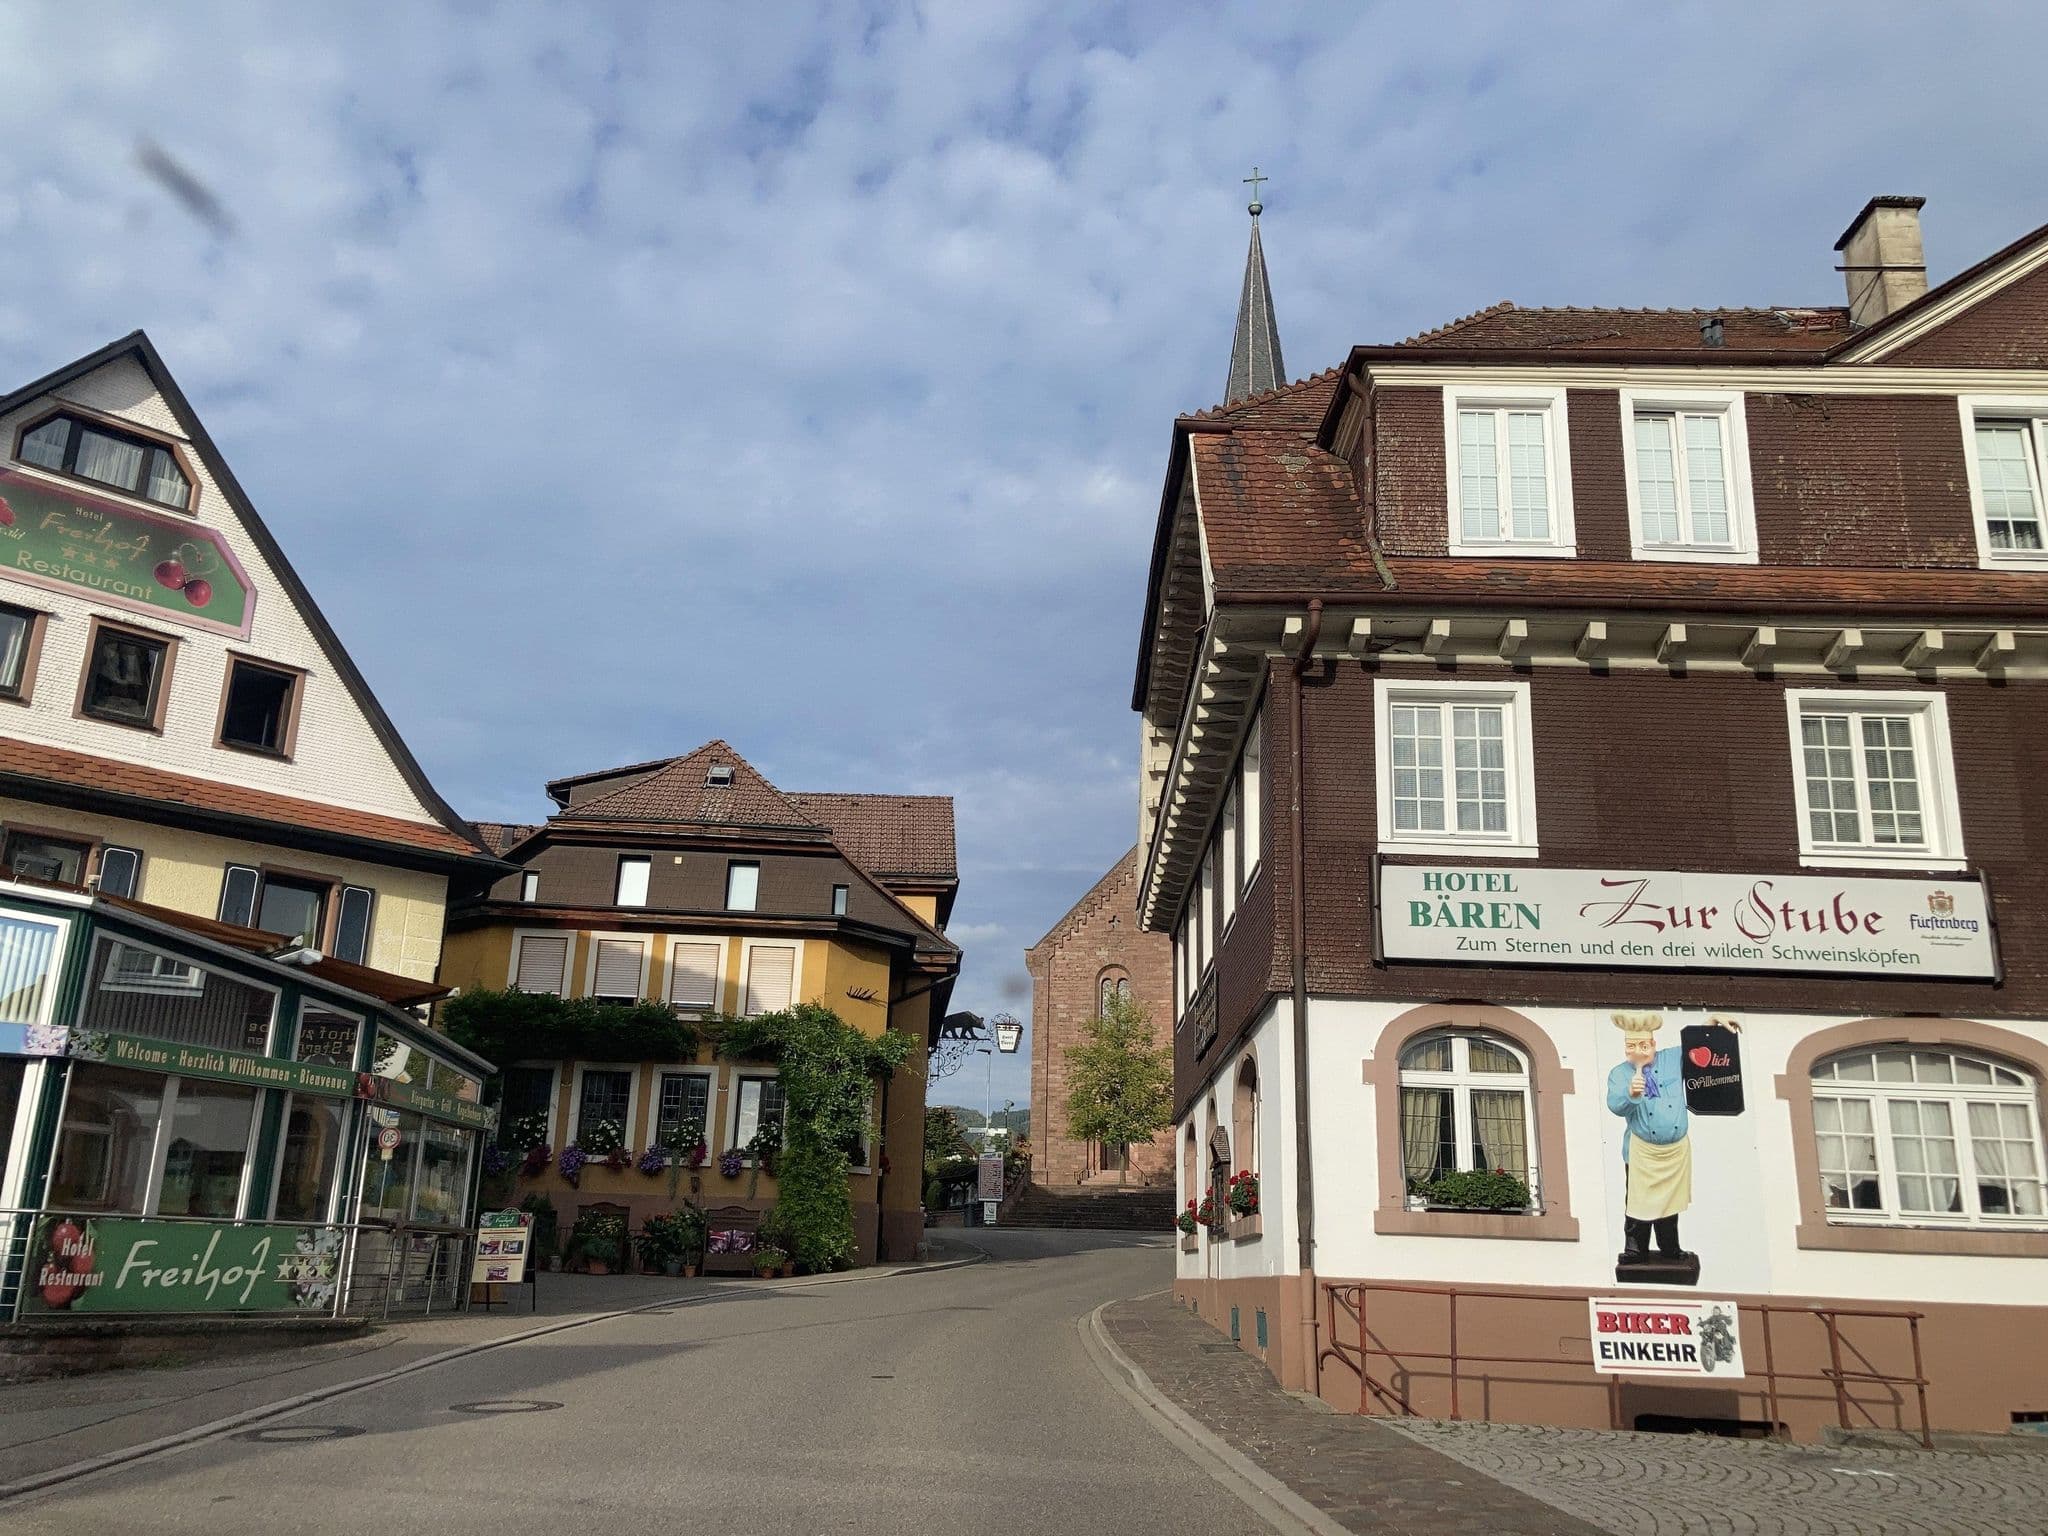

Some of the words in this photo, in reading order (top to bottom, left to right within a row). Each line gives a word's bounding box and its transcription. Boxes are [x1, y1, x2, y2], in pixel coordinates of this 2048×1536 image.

[75, 507, 103, 521] Hotel
[40, 512, 150, 560] Freihof
[17, 551, 152, 600] Restaurant
[1422, 872, 1518, 892] HOTEL
[1408, 895, 1543, 930] BÄREN
[1579, 878, 1718, 934] Zur
[1734, 880, 1885, 944] Stube
[1456, 937, 1497, 952] Zum
[1505, 938, 1572, 953] Sternen
[1581, 940, 1614, 955] und
[1621, 941, 1654, 956] den
[1662, 942, 1695, 957] drei
[1704, 943, 1764, 959] wilden
[1773, 945, 1921, 966] Schweinsköpfen
[117, 1040, 167, 1064] Welcome
[179, 1050, 224, 1072] Herzlich
[229, 1056, 290, 1082] Willkommen
[300, 1069, 347, 1090] Bienvenue
[1711, 1053, 1730, 1067] lich
[1687, 1074, 1740, 1090] Willkommen
[62, 1232, 94, 1257] Hotel
[39, 1267, 104, 1287] Restaurant
[115, 1230, 271, 1304] Freihof
[1596, 1311, 1692, 1336] BIKER
[1600, 1341, 1698, 1363] EINKEHR
